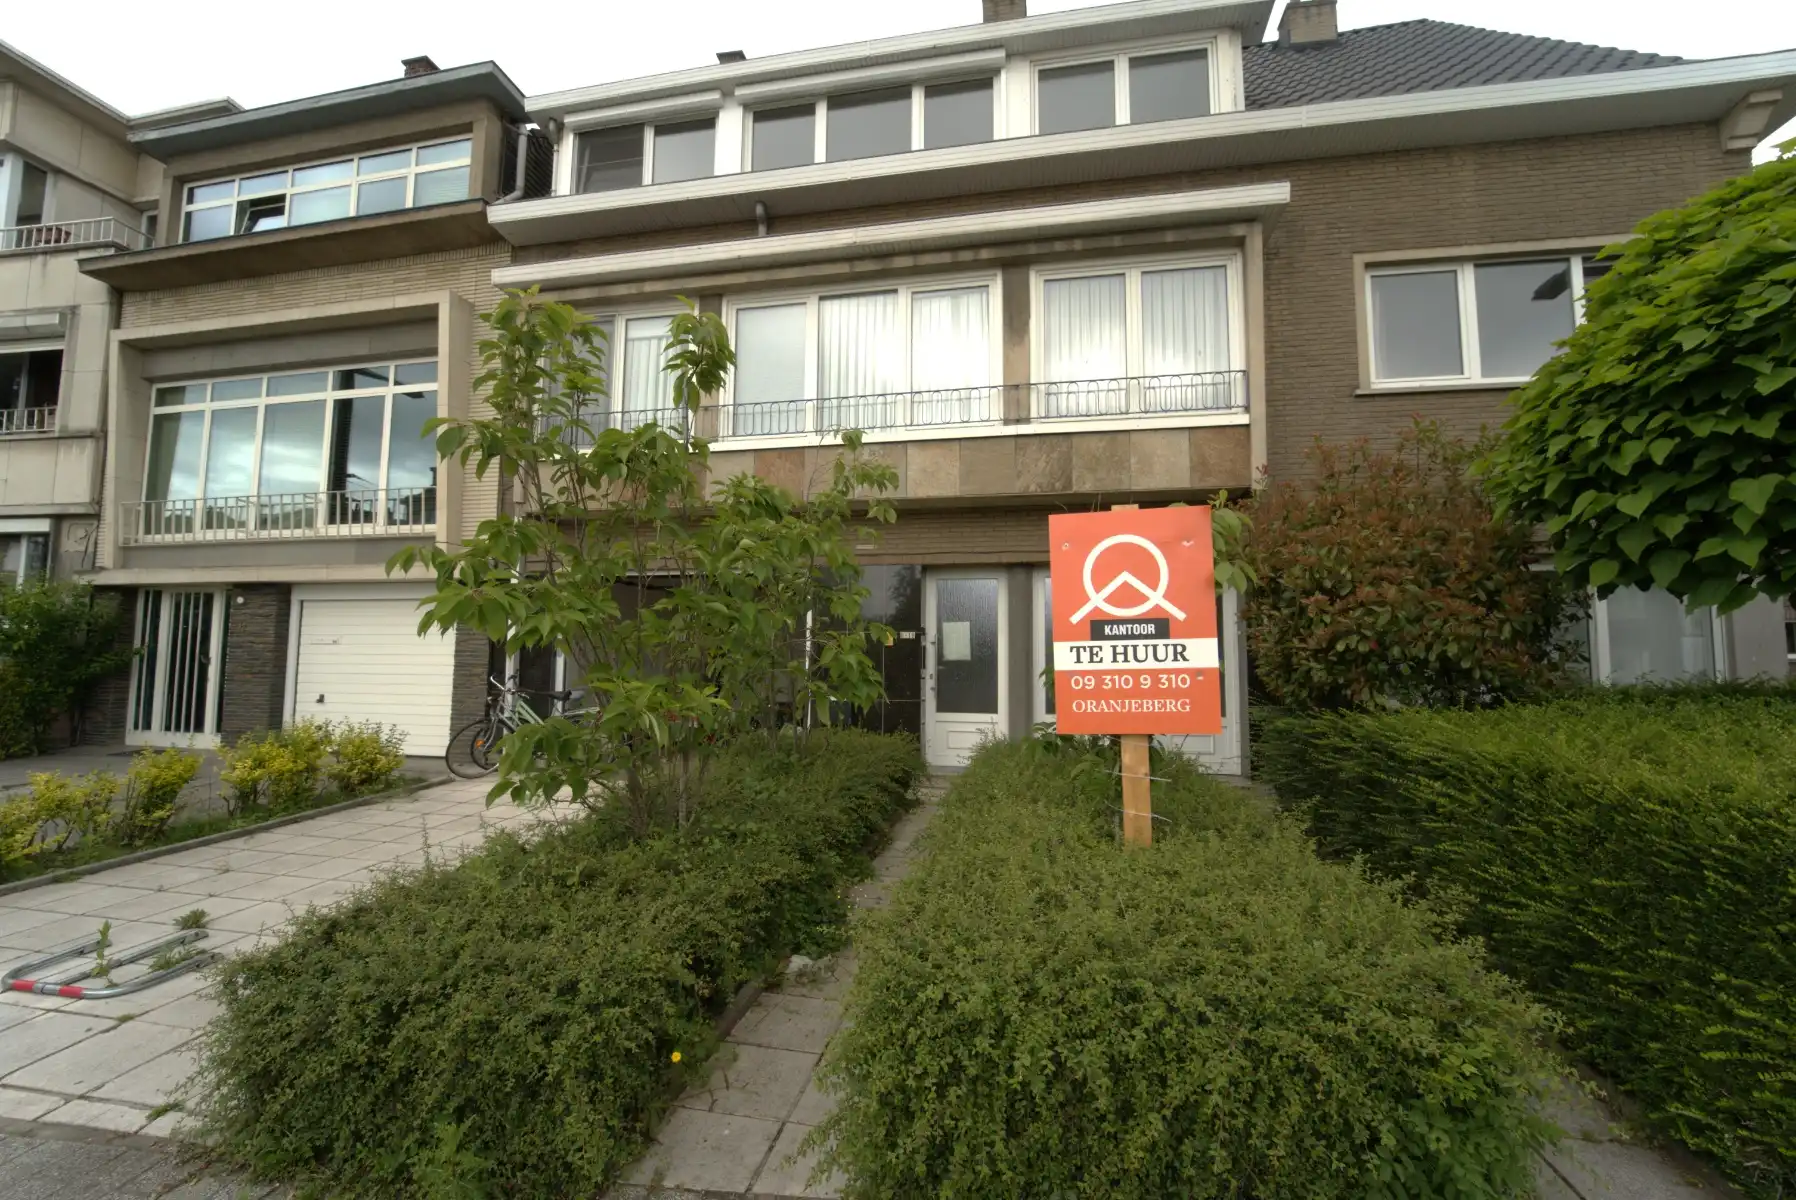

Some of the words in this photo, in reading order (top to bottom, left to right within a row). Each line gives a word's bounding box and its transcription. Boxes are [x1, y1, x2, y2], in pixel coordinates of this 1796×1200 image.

[1104, 623, 1156, 636] KANTOOR
[1069, 645, 1103, 664] TE
[1110, 643, 1190, 663] HUUR
[1071, 675, 1095, 690] 09
[1102, 674, 1133, 690] 310
[1140, 674, 1151, 689] 9
[1158, 673, 1191, 689] 310
[1072, 698, 1191, 713] ORANJEBERG
